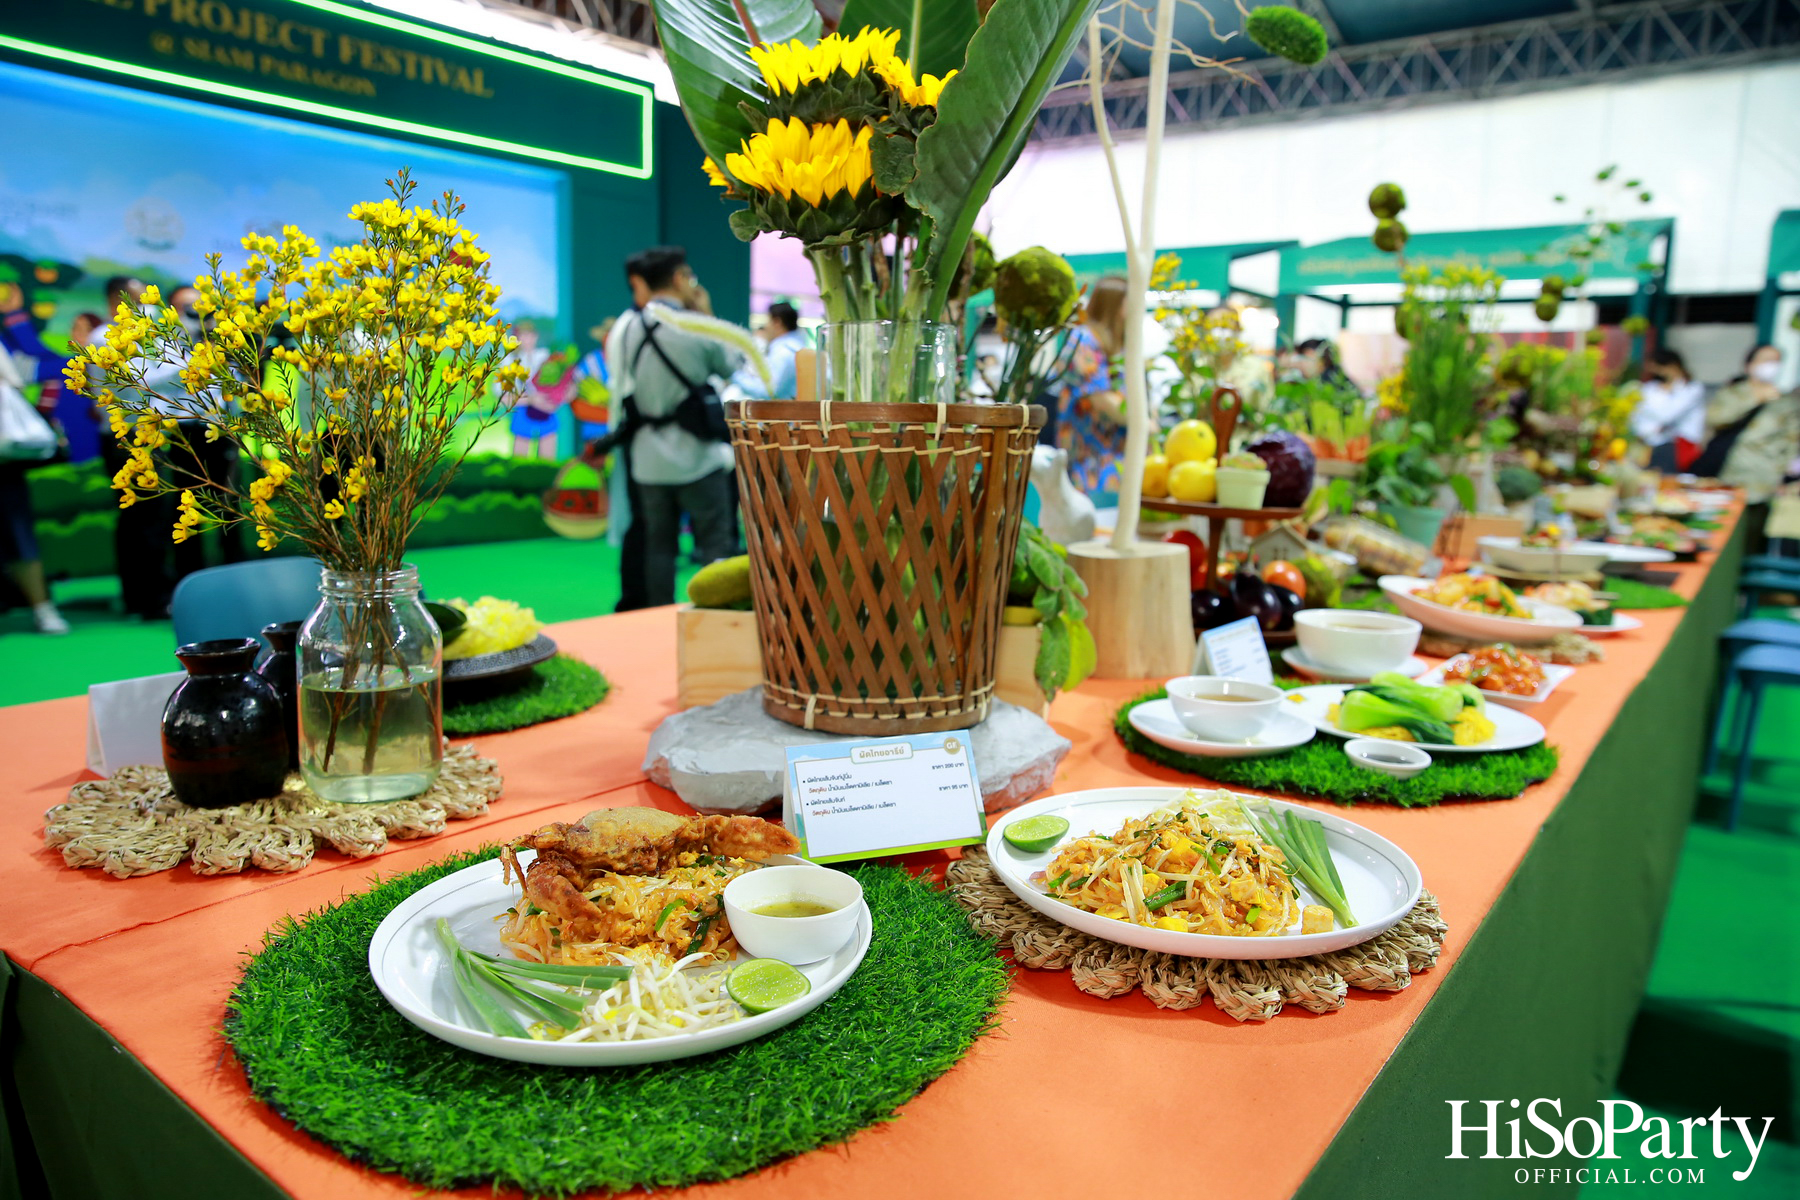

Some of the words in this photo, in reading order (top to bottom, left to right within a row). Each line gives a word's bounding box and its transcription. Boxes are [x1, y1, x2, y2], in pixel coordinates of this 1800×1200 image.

[182, 37, 255, 71] SIAM
[260, 53, 376, 97] PARAGON
[338, 33, 494, 98] FESTIVAL
